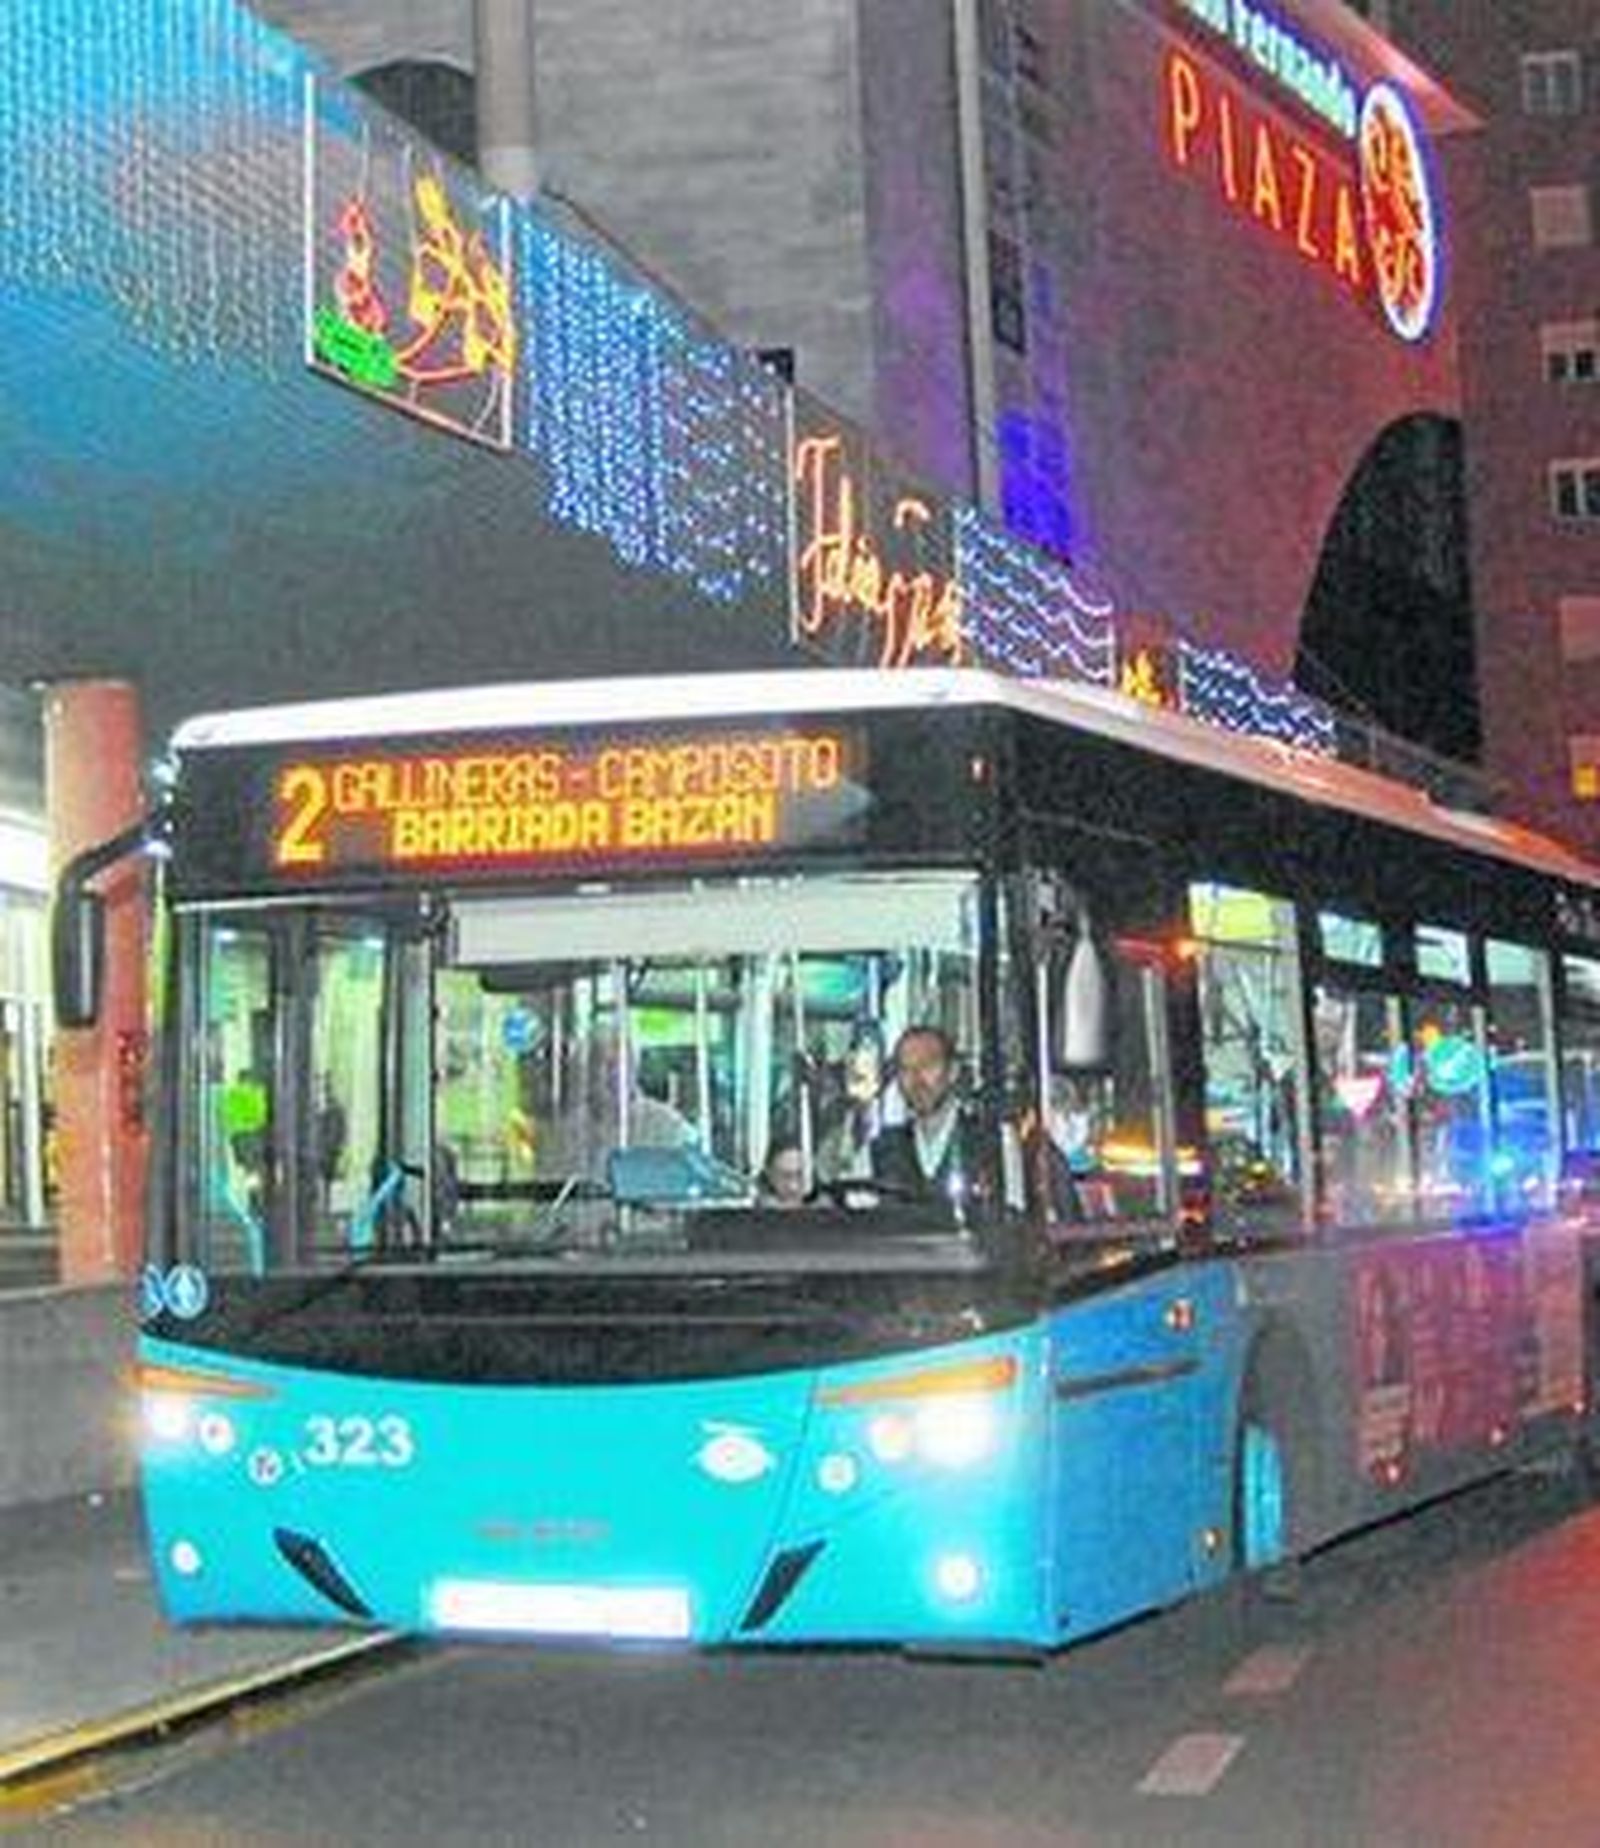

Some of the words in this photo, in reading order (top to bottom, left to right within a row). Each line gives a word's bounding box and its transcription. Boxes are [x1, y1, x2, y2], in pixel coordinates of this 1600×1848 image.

[333, 752, 562, 815] GALLINERAS
[599, 736, 840, 800] CAMPOSOTO
[278, 763, 326, 865] 2
[391, 800, 610, 858] BARRIADA
[304, 1412, 414, 1466] 323
